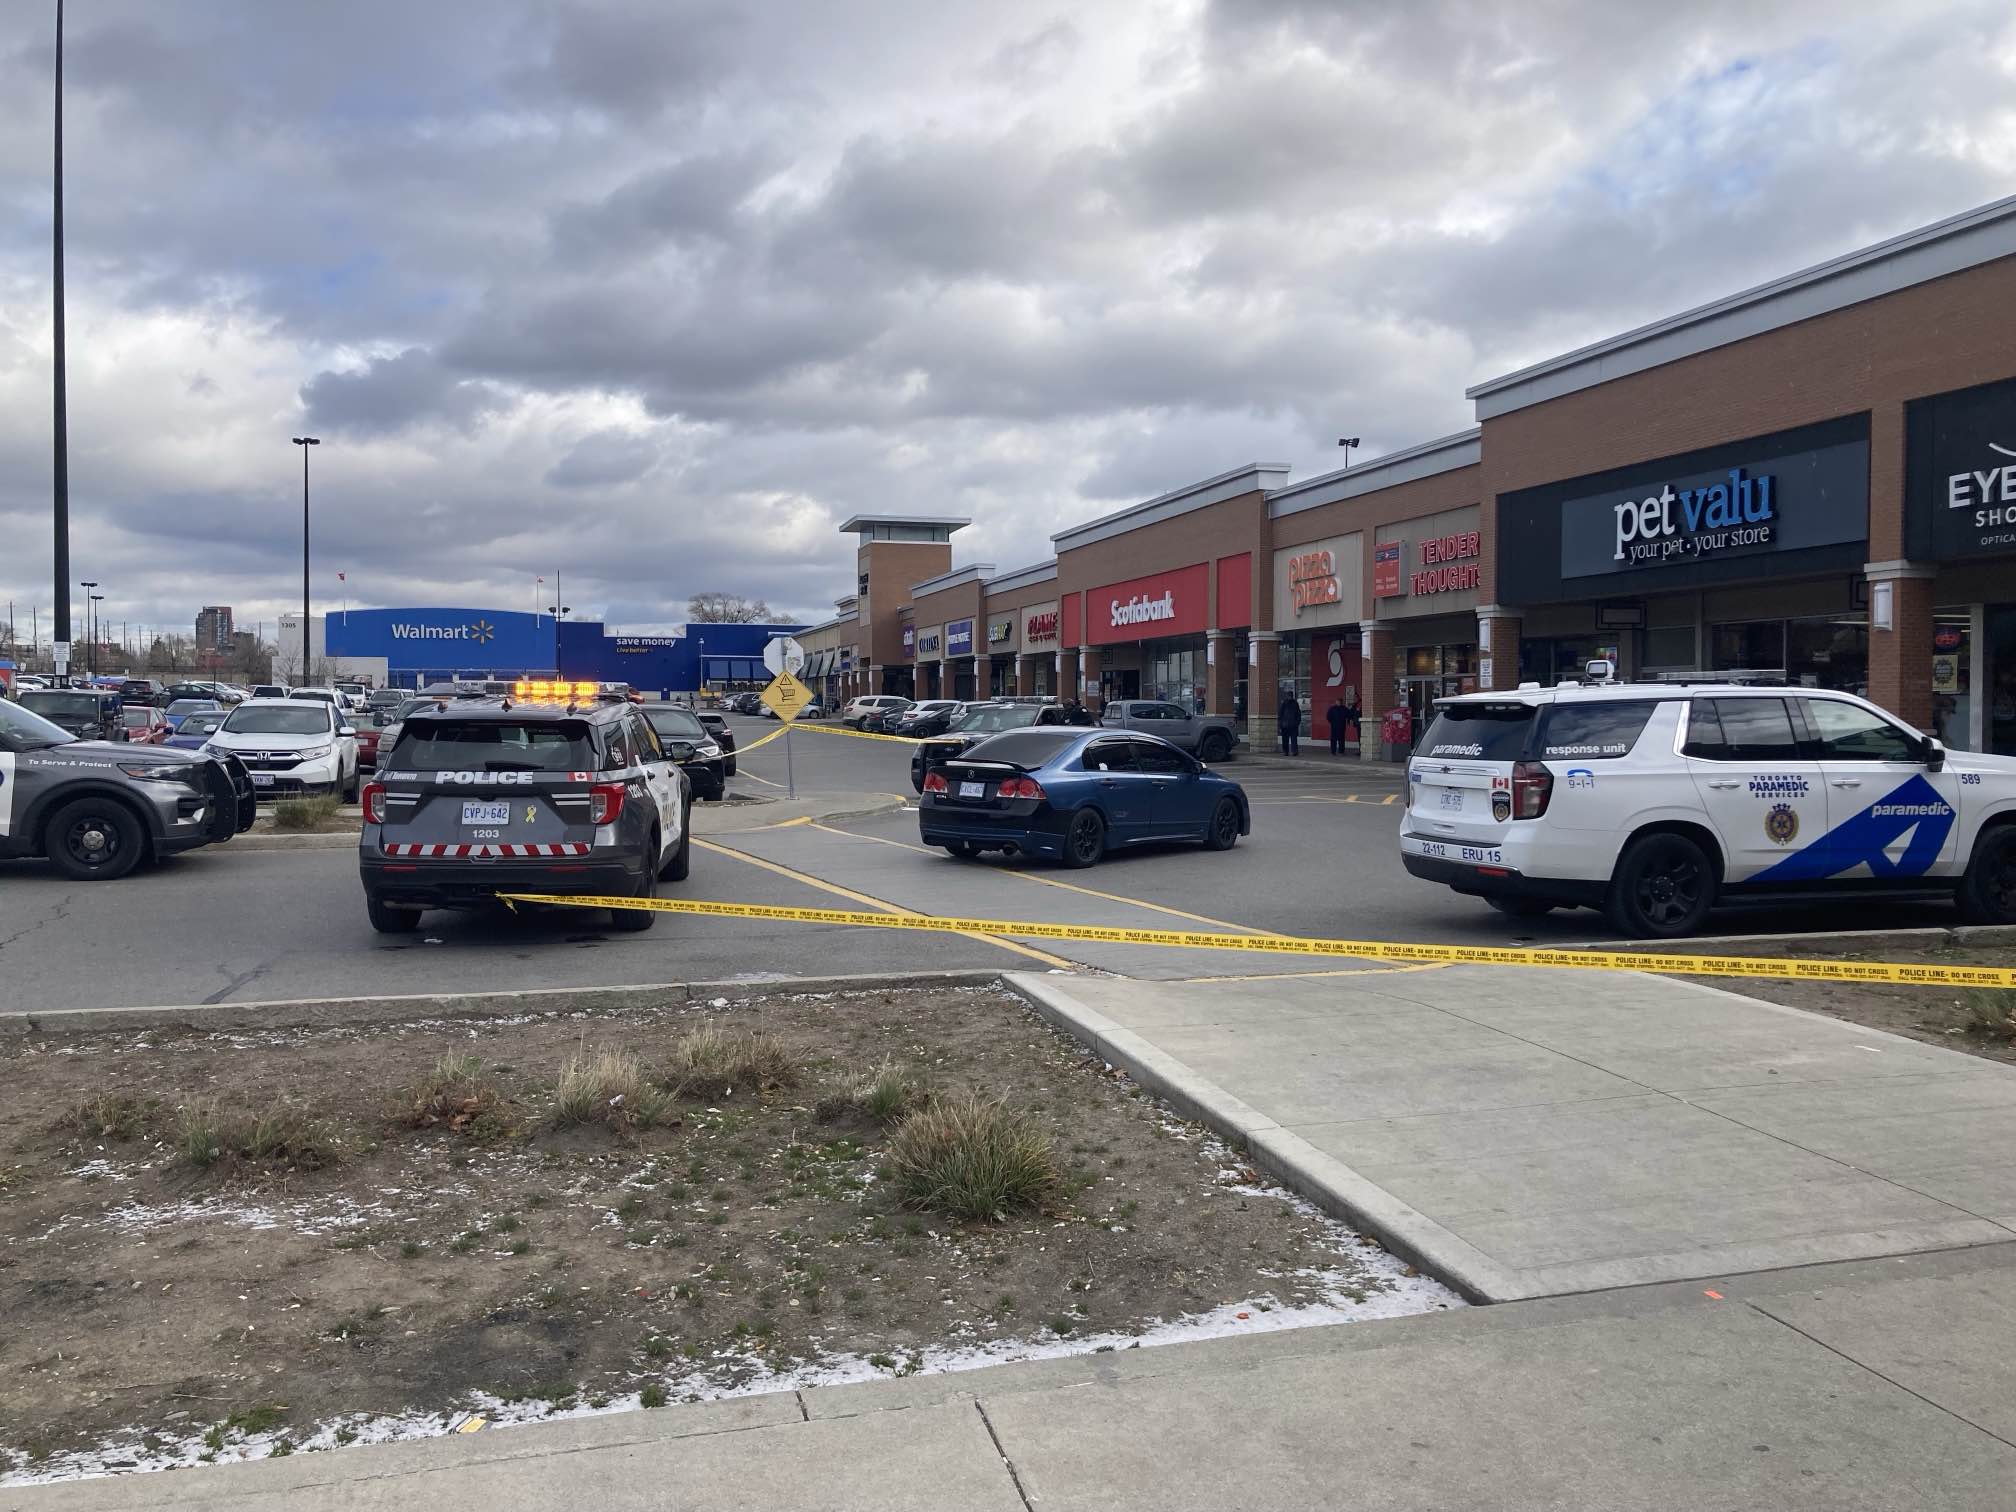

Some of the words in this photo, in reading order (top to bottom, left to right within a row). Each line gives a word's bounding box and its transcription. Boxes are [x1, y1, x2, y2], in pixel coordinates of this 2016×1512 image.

[1614, 484, 1675, 560] pet
[1679, 468, 1772, 532] valu
[1419, 531, 1480, 564] TENDER
[1630, 544, 1660, 564] your
[1662, 539, 1684, 560] pet
[1694, 532, 1728, 557] your
[1731, 526, 1769, 546] store
[1111, 590, 1175, 626] Scotiabank
[392, 624, 468, 639] Walmart
[642, 638, 676, 647] money
[1431, 744, 1483, 756] paramedic
[1546, 745, 1599, 755] response
[1603, 743, 1626, 753] unit
[436, 772, 534, 784] POLICE
[1569, 779, 1594, 788] 9-1-1
[1961, 774, 1980, 784] 589
[1748, 781, 1809, 792] PARAMEDIC
[1872, 802, 1950, 818] paramedic
[472, 830, 499, 838] 1203
[1423, 842, 1445, 855] 22-112
[1462, 848, 1483, 861] ERU
[1488, 851, 1501, 862] 15
[1797, 964, 1821, 972] POLICE
